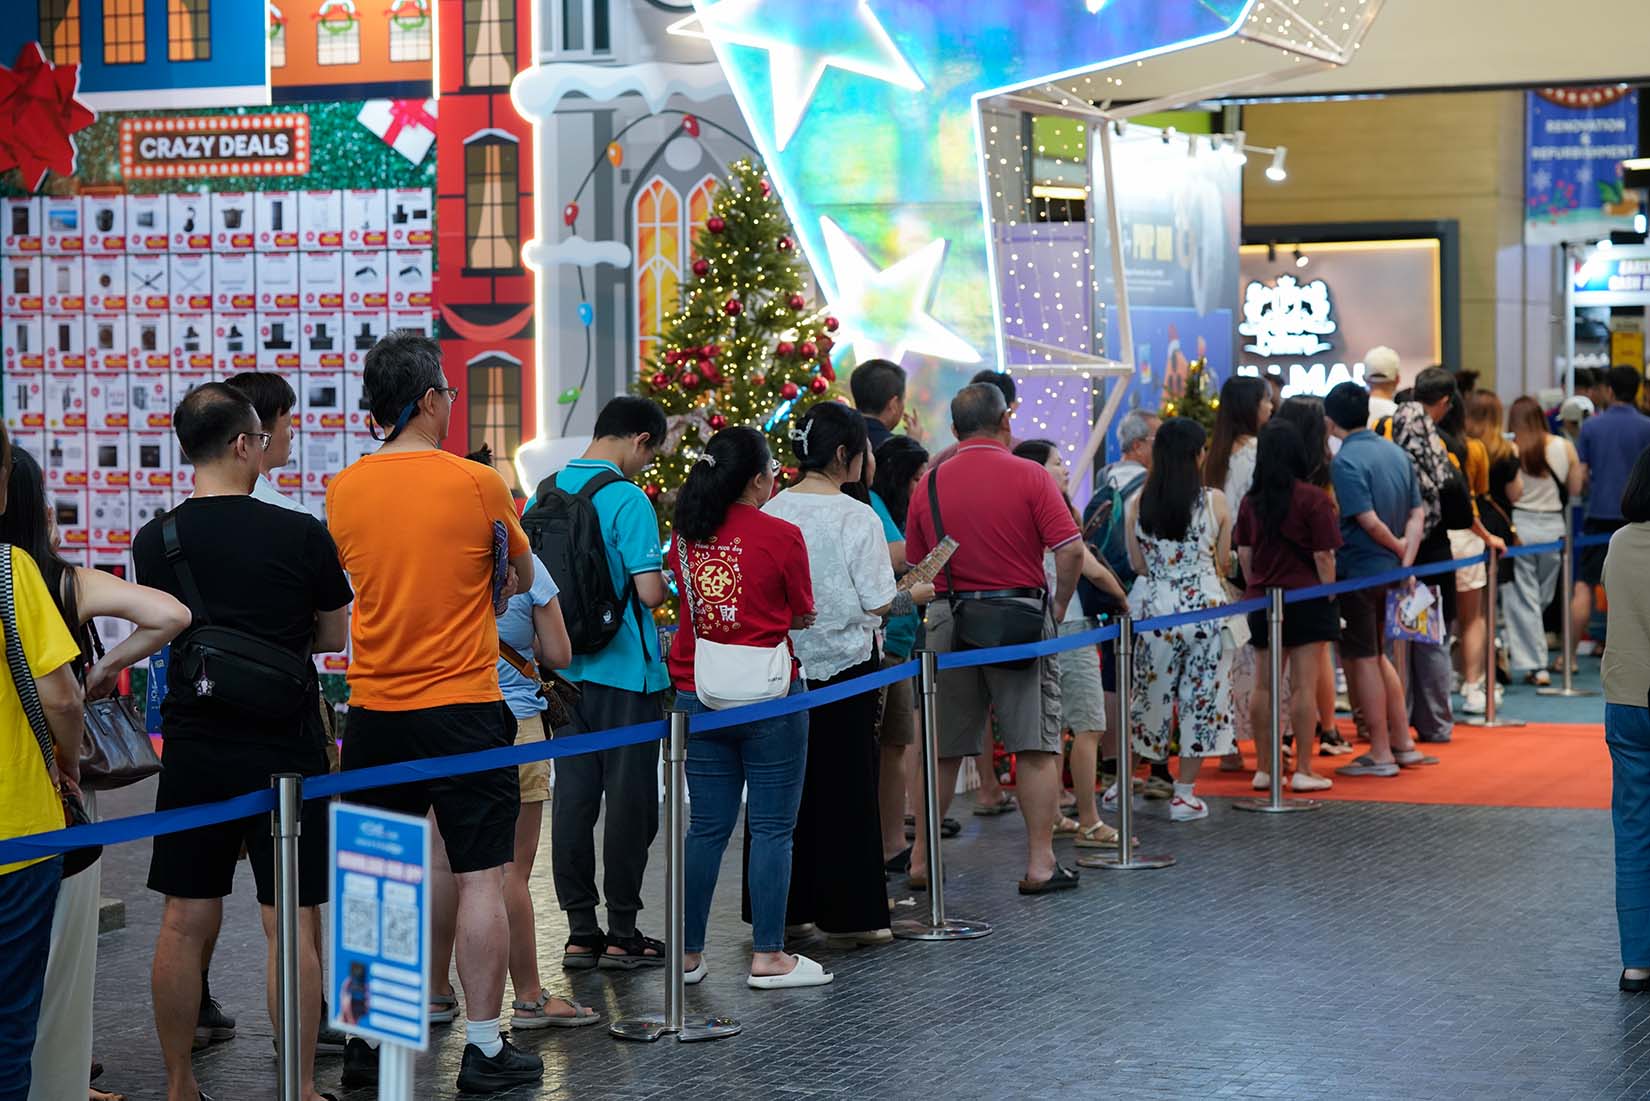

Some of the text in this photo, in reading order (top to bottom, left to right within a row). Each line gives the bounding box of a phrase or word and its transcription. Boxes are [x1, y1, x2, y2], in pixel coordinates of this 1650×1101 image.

[139, 133, 289, 159] CRAZY DEALS
[732, 545, 743, 555] day
[698, 565, 733, 598] 發
[719, 604, 738, 622] 財
